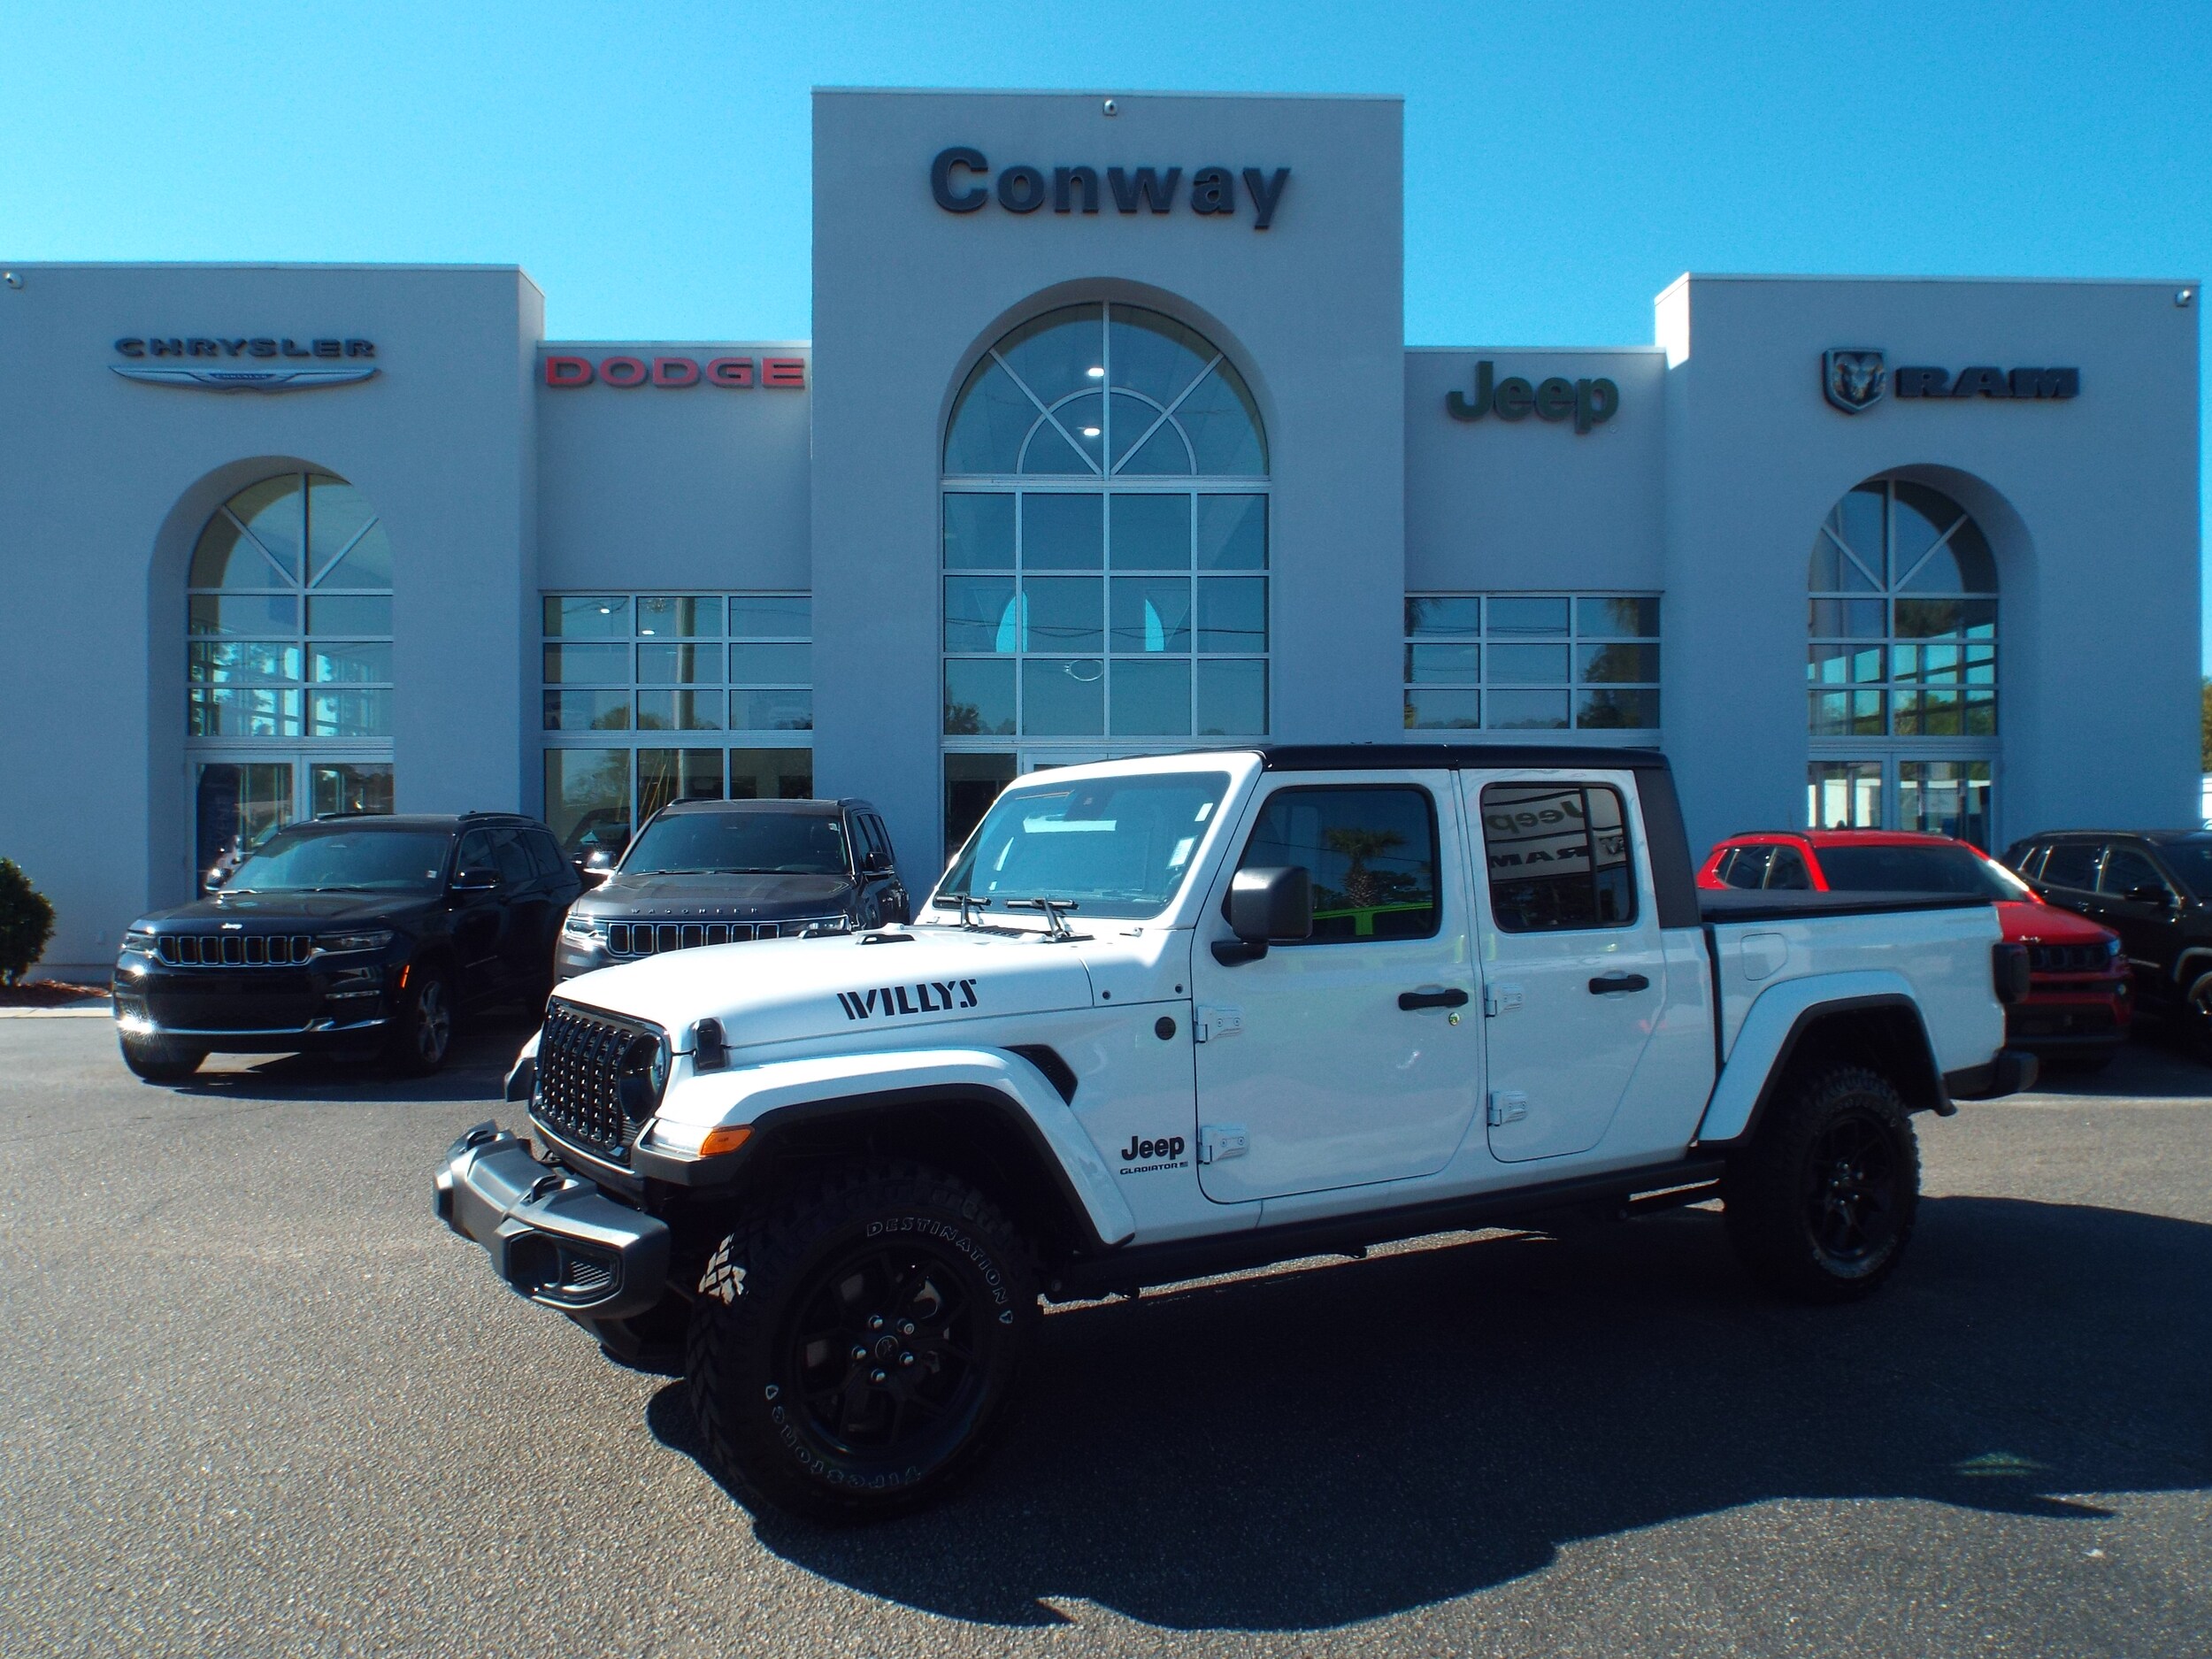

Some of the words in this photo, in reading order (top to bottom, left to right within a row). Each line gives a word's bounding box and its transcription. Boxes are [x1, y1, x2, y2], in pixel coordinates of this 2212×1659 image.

[931, 147, 1292, 230] Conway
[115, 334, 375, 357] CHRYSLER
[545, 357, 805, 389] DODGE
[1895, 366, 2079, 399] RAM
[1446, 361, 1619, 434] Jeep
[837, 979, 978, 1020] WILLYS
[1121, 1135, 1185, 1161] Jeep
[1120, 1163, 1178, 1175] GLADIATOR
[866, 1217, 1008, 1305] DESTINATION
